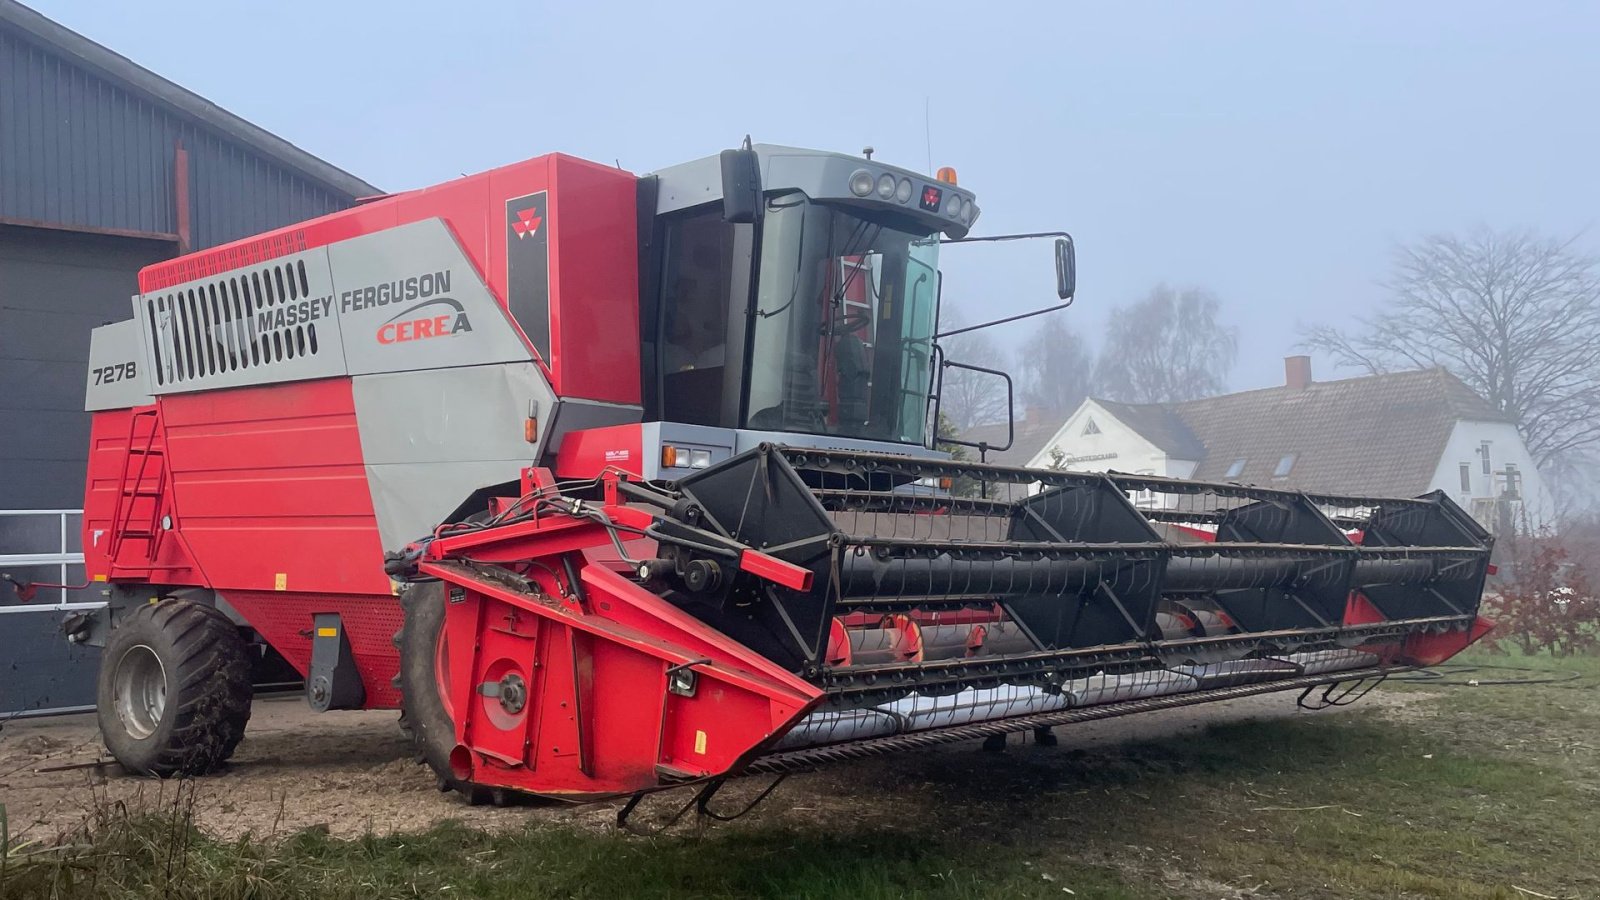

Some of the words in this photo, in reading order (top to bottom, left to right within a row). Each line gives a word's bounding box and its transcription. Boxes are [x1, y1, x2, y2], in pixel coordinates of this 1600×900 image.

[258, 295, 332, 333] MASSEY
[341, 270, 451, 314] FERGUSON
[376, 312, 472, 345] CEREA
[93, 361, 136, 386] 7278
